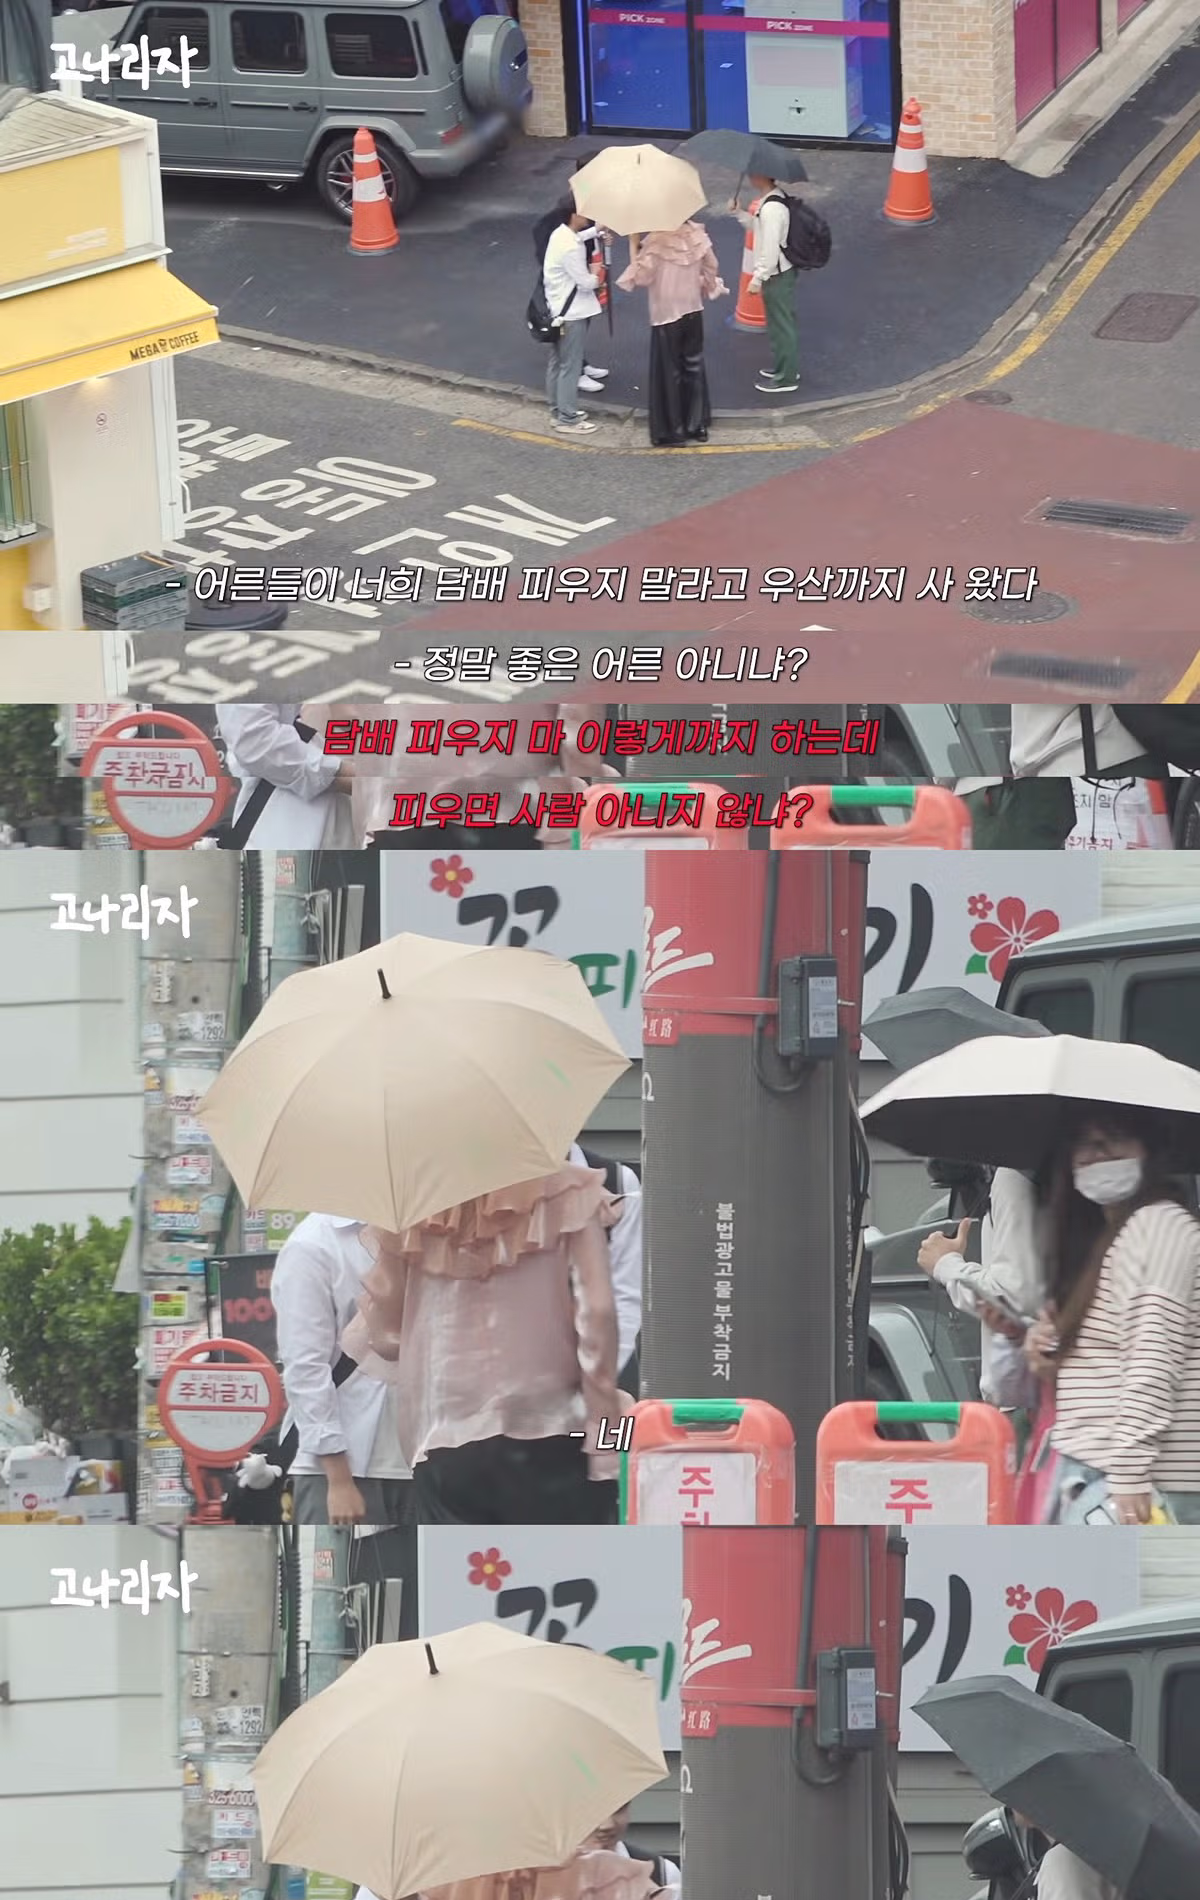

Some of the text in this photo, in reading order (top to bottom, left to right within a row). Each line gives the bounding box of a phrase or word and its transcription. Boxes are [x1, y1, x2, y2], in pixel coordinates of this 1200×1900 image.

[618, 13, 645, 24] PICK
[766, 20, 793, 32] PICK
[129, 330, 200, 362] MEGA COFFEE
[271, 1213, 296, 1230] 89
[713, 1202, 735, 1299] 불법광고물
[711, 1304, 734, 1382] 부착금지
[178, 1381, 259, 1404] 주차금지
